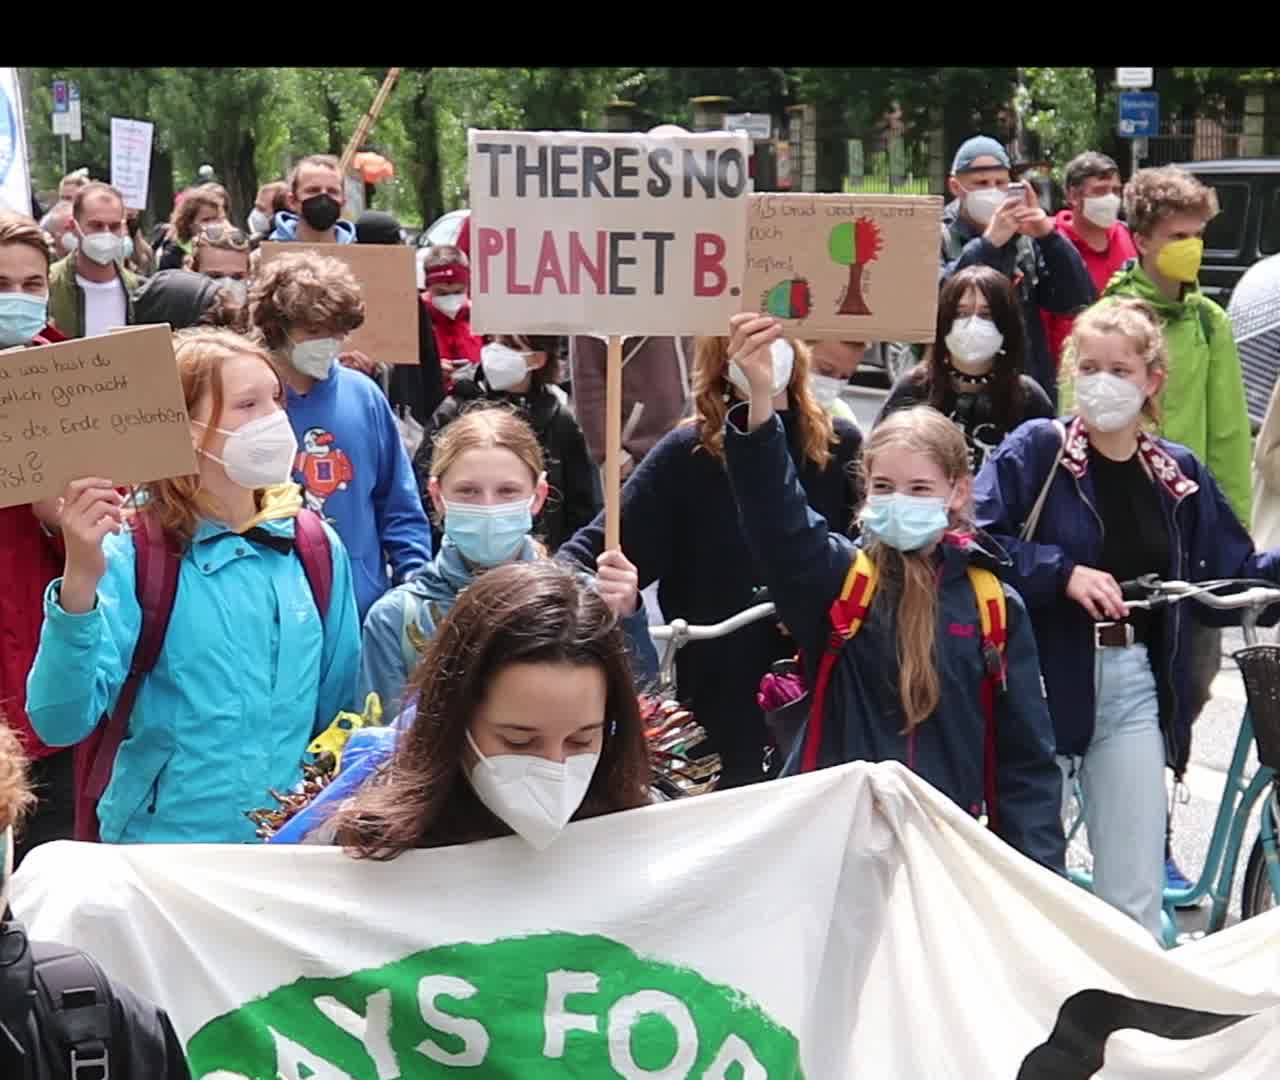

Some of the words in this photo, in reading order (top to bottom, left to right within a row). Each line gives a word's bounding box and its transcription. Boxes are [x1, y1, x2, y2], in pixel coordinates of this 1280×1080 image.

[682, 148, 746, 199] NO
[478, 227, 675, 296] PLANET
[693, 232, 741, 297] B.
[20, 364, 49, 377] was
[54, 354, 86, 373] hast
[91, 353, 111, 367] du
[22, 420, 51, 440] die
[60, 415, 100, 435] Erde
[110, 407, 186, 434] gestorben
